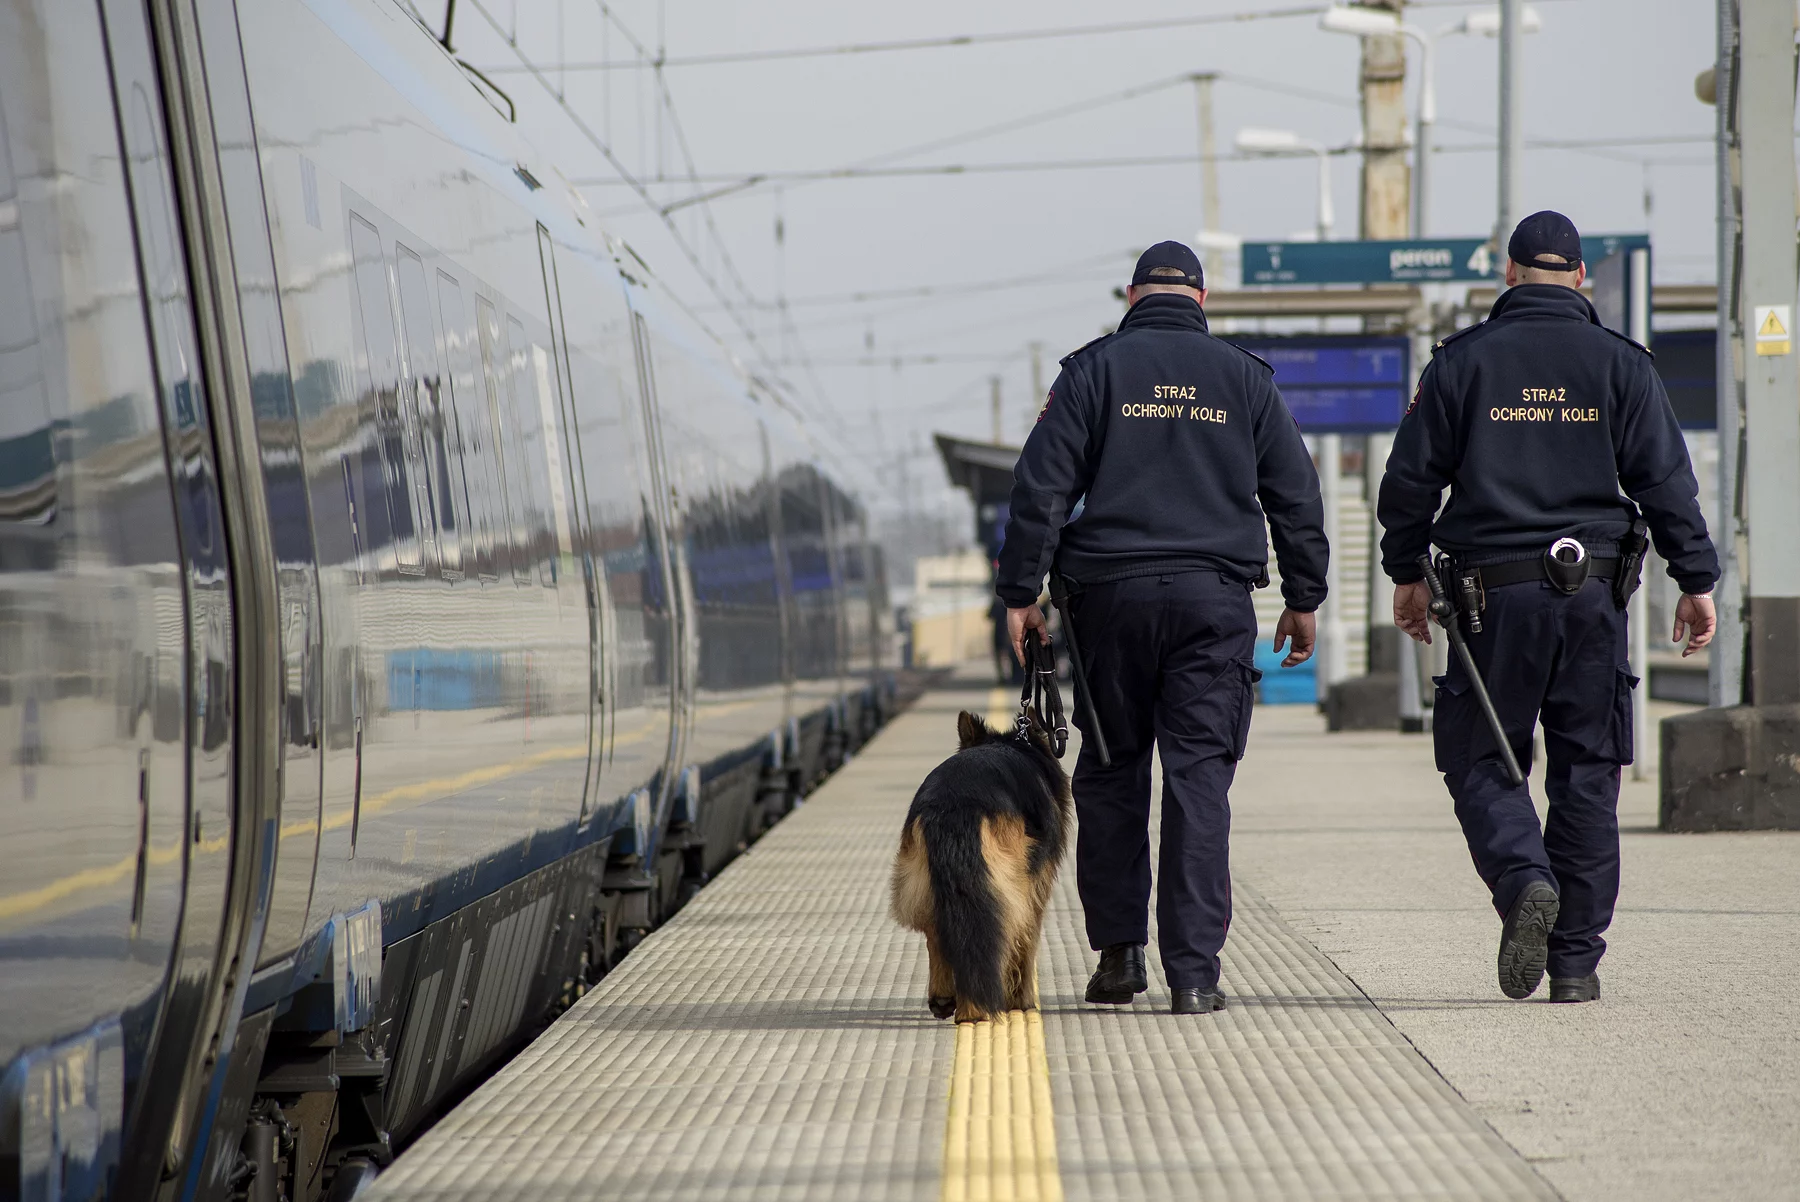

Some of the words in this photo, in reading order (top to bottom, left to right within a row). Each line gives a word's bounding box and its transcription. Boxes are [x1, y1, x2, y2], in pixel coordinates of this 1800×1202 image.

[1390, 248, 1452, 269] peron
[1467, 246, 1492, 276] 4
[1154, 385, 1197, 400] STRAŻ
[1522, 387, 1566, 402] STRAŻ
[1121, 403, 1184, 418] OCHRONY
[1190, 406, 1227, 424] KOLEI
[1490, 407, 1554, 422] OCHRONY
[1561, 408, 1599, 422] KOLEI
